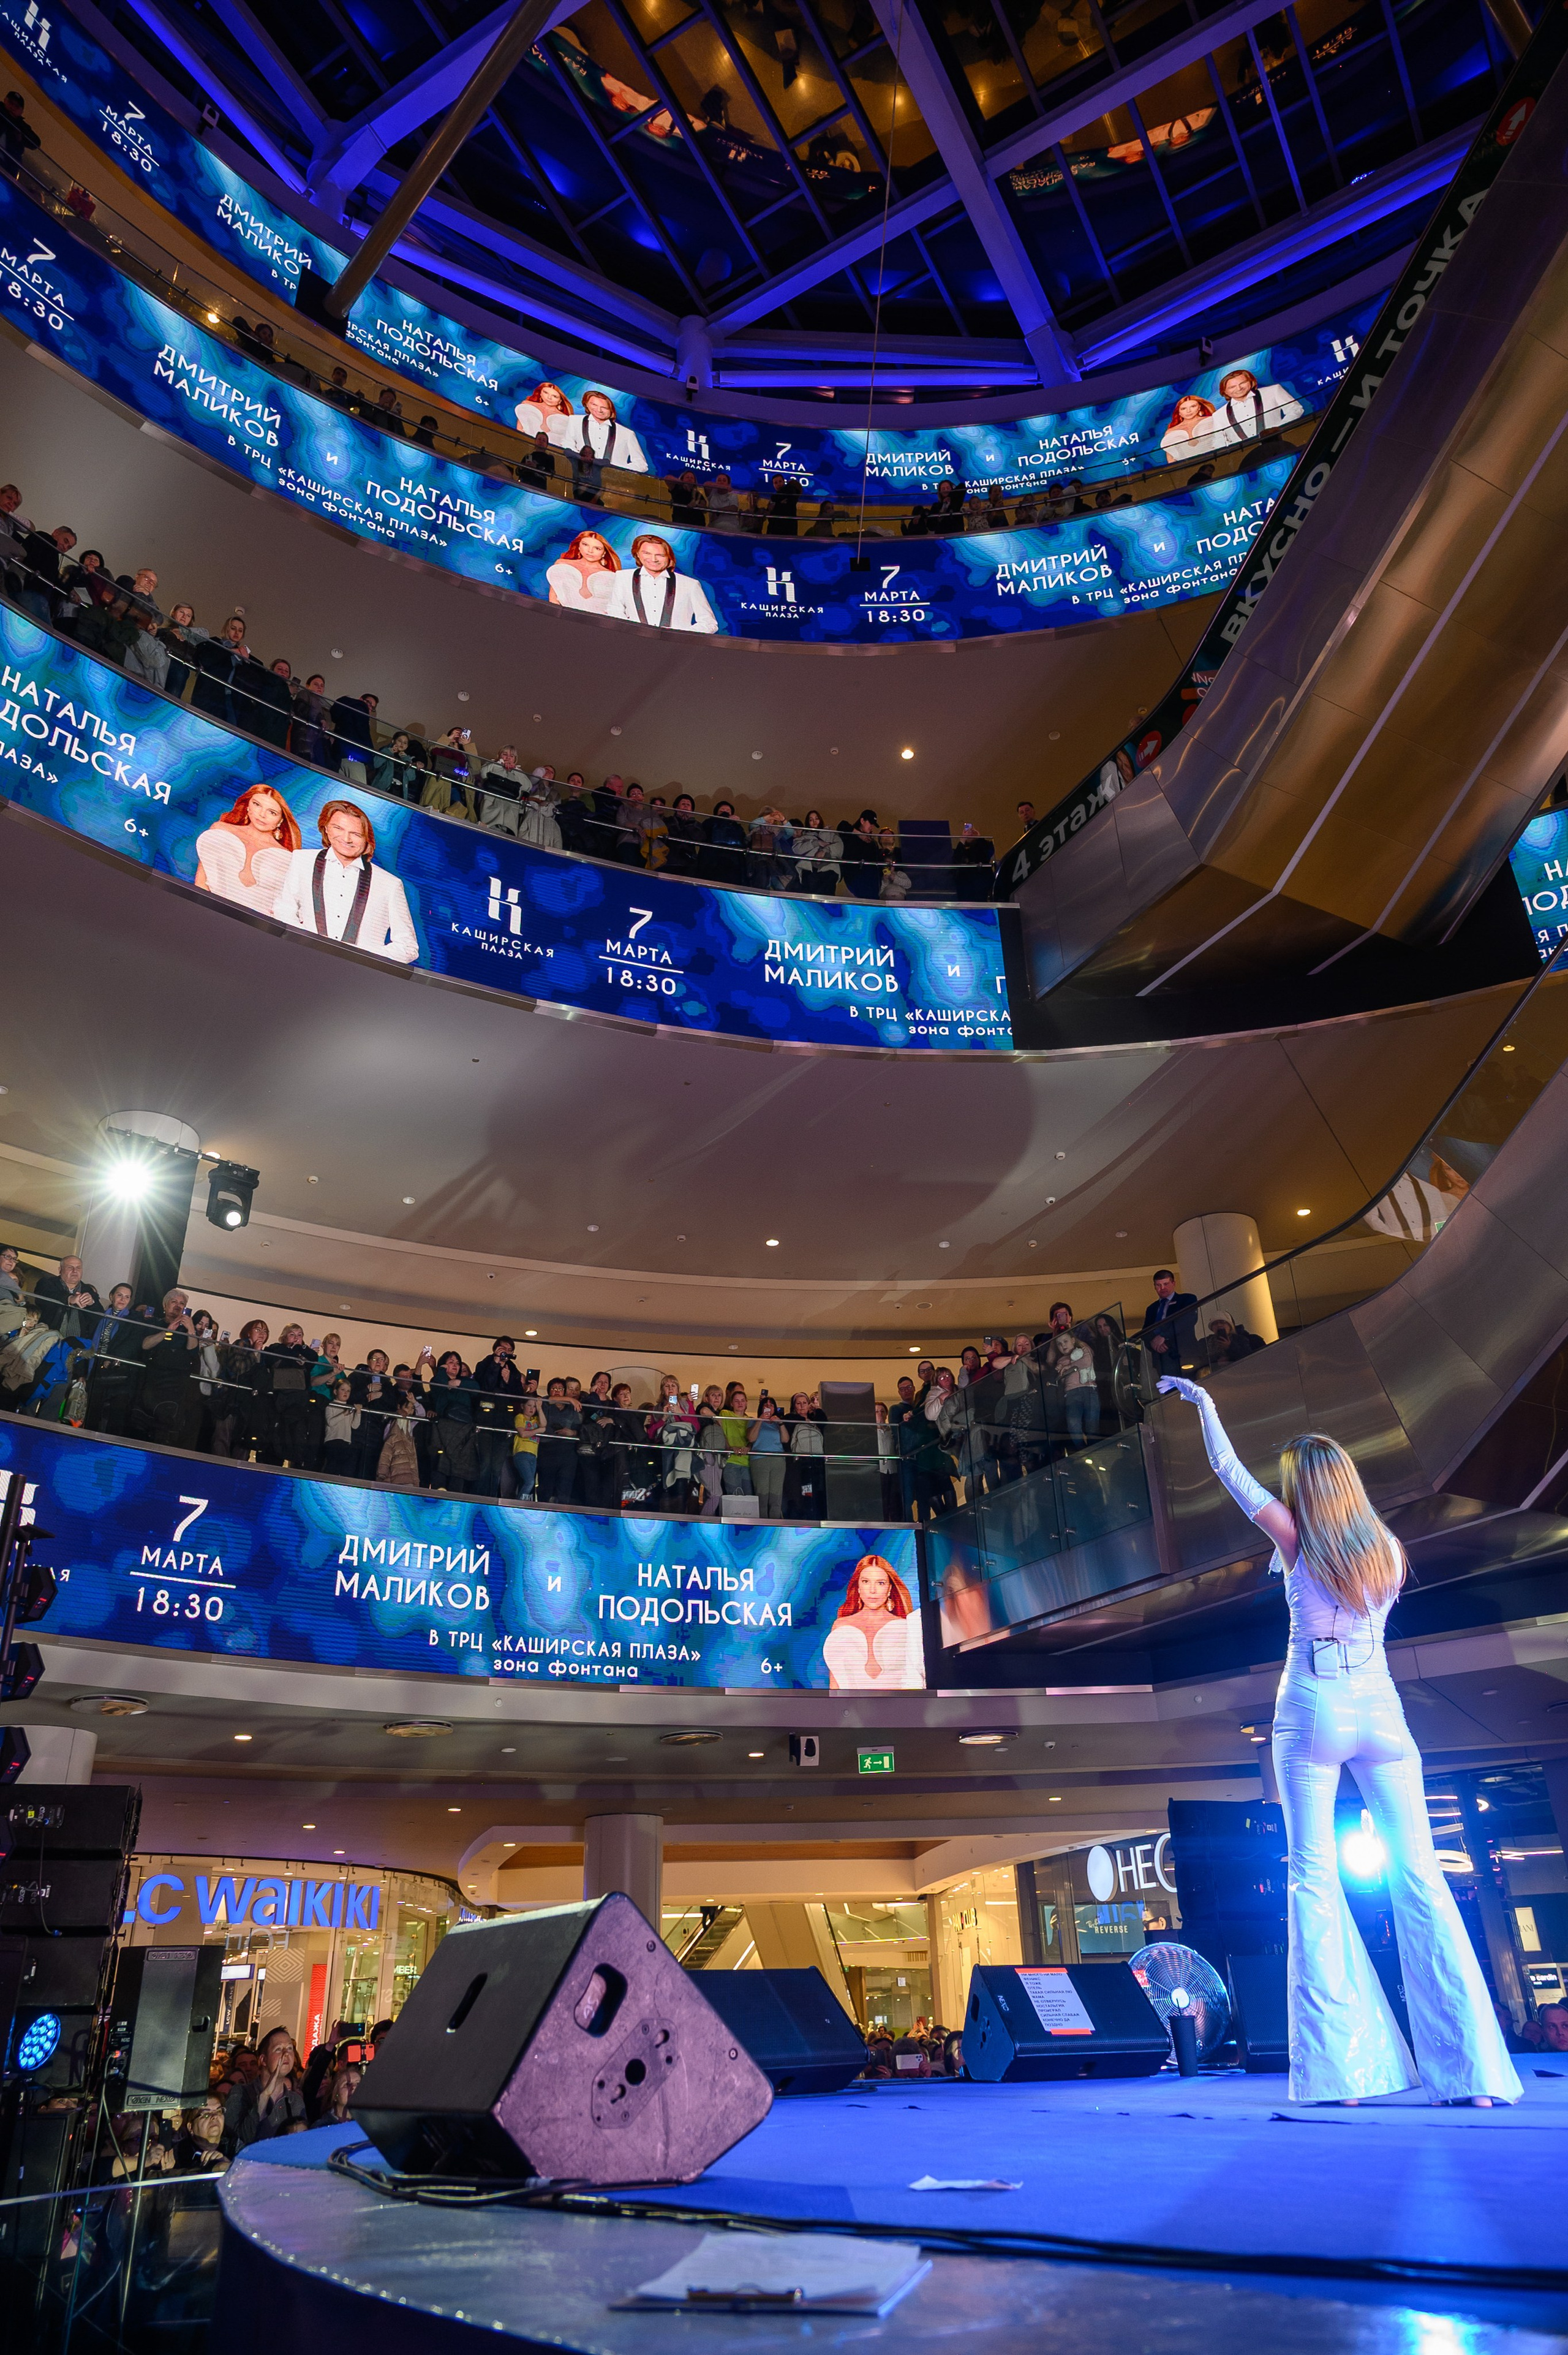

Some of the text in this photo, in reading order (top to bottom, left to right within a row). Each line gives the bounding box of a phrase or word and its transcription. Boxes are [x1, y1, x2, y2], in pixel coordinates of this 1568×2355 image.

[2, 13, 67, 83] АШИРСКАЯ
[14, 31, 44, 66] ПЛАЗА
[124, 101, 145, 120] 7
[103, 121, 151, 172] 18:30
[106, 105, 153, 155] МАРТА
[217, 205, 300, 274] МАЛИКО
[220, 194, 312, 270] ДМИТРИЙ
[27, 238, 56, 264] 7
[1, 248, 64, 307] МАРТА
[271, 269, 439, 377] В ТР РСКАЯ ПЛАЗА»
[345, 330, 399, 365] фонтана
[377, 319, 498, 391] ПОДОЛЬСКАЯ
[402, 319, 476, 366] НАТАЛЬЯ
[158, 344, 281, 428] ДМИТРИЙ
[475, 396, 489, 406] 6+
[154, 360, 338, 465] МАЛИКОВ и
[1221, 464, 1330, 644] ВКУСНО
[1352, 376, 1382, 410] И
[1378, 190, 1487, 359] ТОЧКА
[666, 453, 730, 471] КАШИРСКАЯ
[776, 442, 791, 459] 7
[865, 433, 1139, 477] МАЛИКОВ ПОДОЛЬСКАЯ
[866, 449, 951, 465] ДМИТРИЙ
[1039, 425, 1113, 450] НАТАЛЬЯ
[685, 463, 711, 472] ПЛАЗА
[763, 459, 805, 471] МАРТА
[764, 474, 809, 487] 1:0
[965, 473, 1036, 488] КАШИРСКАЯ
[228, 435, 447, 546] В ТРЦ «КАШИРСКАЯ ПЛАЗА»
[278, 478, 395, 538] зона фонтана
[400, 477, 495, 524] НАТАЛЬЯ
[366, 480, 523, 554] ПОДОЛЬСКАЯ
[996, 497, 1276, 580] ДМИТРИЙ и НАТА
[495, 564, 513, 575] 6+
[880, 565, 900, 589] 7
[997, 564, 1112, 595] МАЛИКОВ
[1072, 560, 1222, 604] В ТРЦ «КАШИРСКАЯ
[1124, 568, 1237, 603] зона фонтана
[741, 602, 823, 613] КАШИРСКАЯ
[865, 591, 920, 602] МАРТА
[867, 609, 925, 622] 18:30
[0, 665, 137, 758] НАТАЛЬЯ
[0, 698, 172, 806] ДОЛЬСКАЯ
[0, 740, 59, 784] АЗА»
[124, 818, 149, 837] 6+
[1012, 849, 1032, 884] 4
[451, 923, 554, 958] КАШИРСКАЯ
[628, 907, 653, 939] 7
[481, 942, 522, 959] ПЛАЗА
[606, 939, 672, 964] МАРТА
[764, 939, 961, 977] ДМИТРИЙ и
[607, 967, 676, 995] 18:30
[764, 964, 898, 992] МАЛИКОВ
[850, 1005, 1011, 1022] В ТРЦ «КАШИРСКА
[908, 1024, 1013, 1038] зона фонт
[173, 1495, 209, 1542] 7
[141, 1546, 223, 1576] МАРТА
[338, 1534, 754, 1592] ДМИТРИЙ и НАТАЛЬЯ
[137, 1587, 224, 1621] 18:30
[335, 1570, 792, 1627] МАЛИКОВ ПОДОЛЬСКАЯ
[429, 1629, 701, 1661] В ТРЦ «КАШИРСКАЯ ПЛАЗА»
[494, 1659, 638, 1677] зона фонтана
[761, 1658, 783, 1674] 6+
[1094, 1925, 1129, 1934] REVERSE
